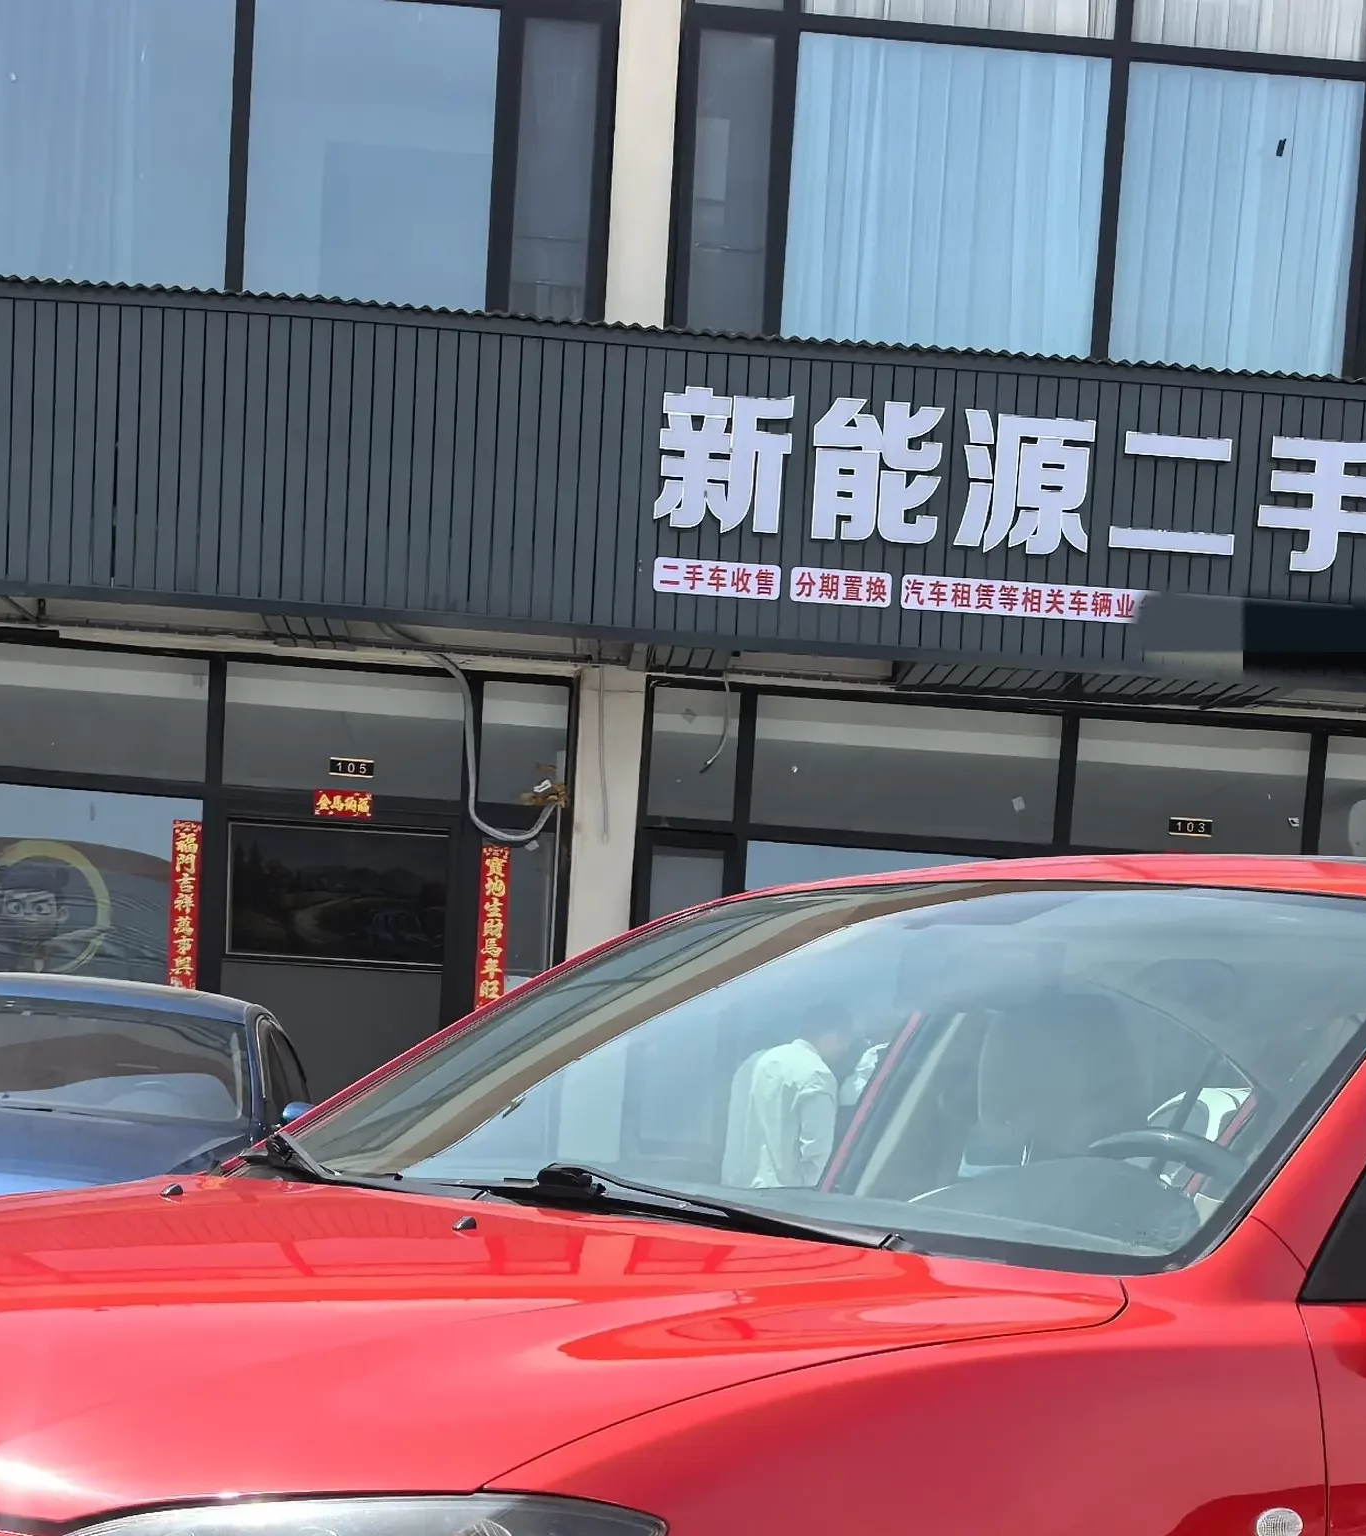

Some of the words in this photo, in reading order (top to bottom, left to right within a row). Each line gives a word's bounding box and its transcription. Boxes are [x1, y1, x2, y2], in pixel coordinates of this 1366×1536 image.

[658, 563, 776, 595] 二手车收售
[795, 571, 888, 604] 分期置换
[904, 577, 1145, 620] 汽车租赁等相关车辆业
[336, 761, 367, 775] 105
[1176, 821, 1206, 833] 103
